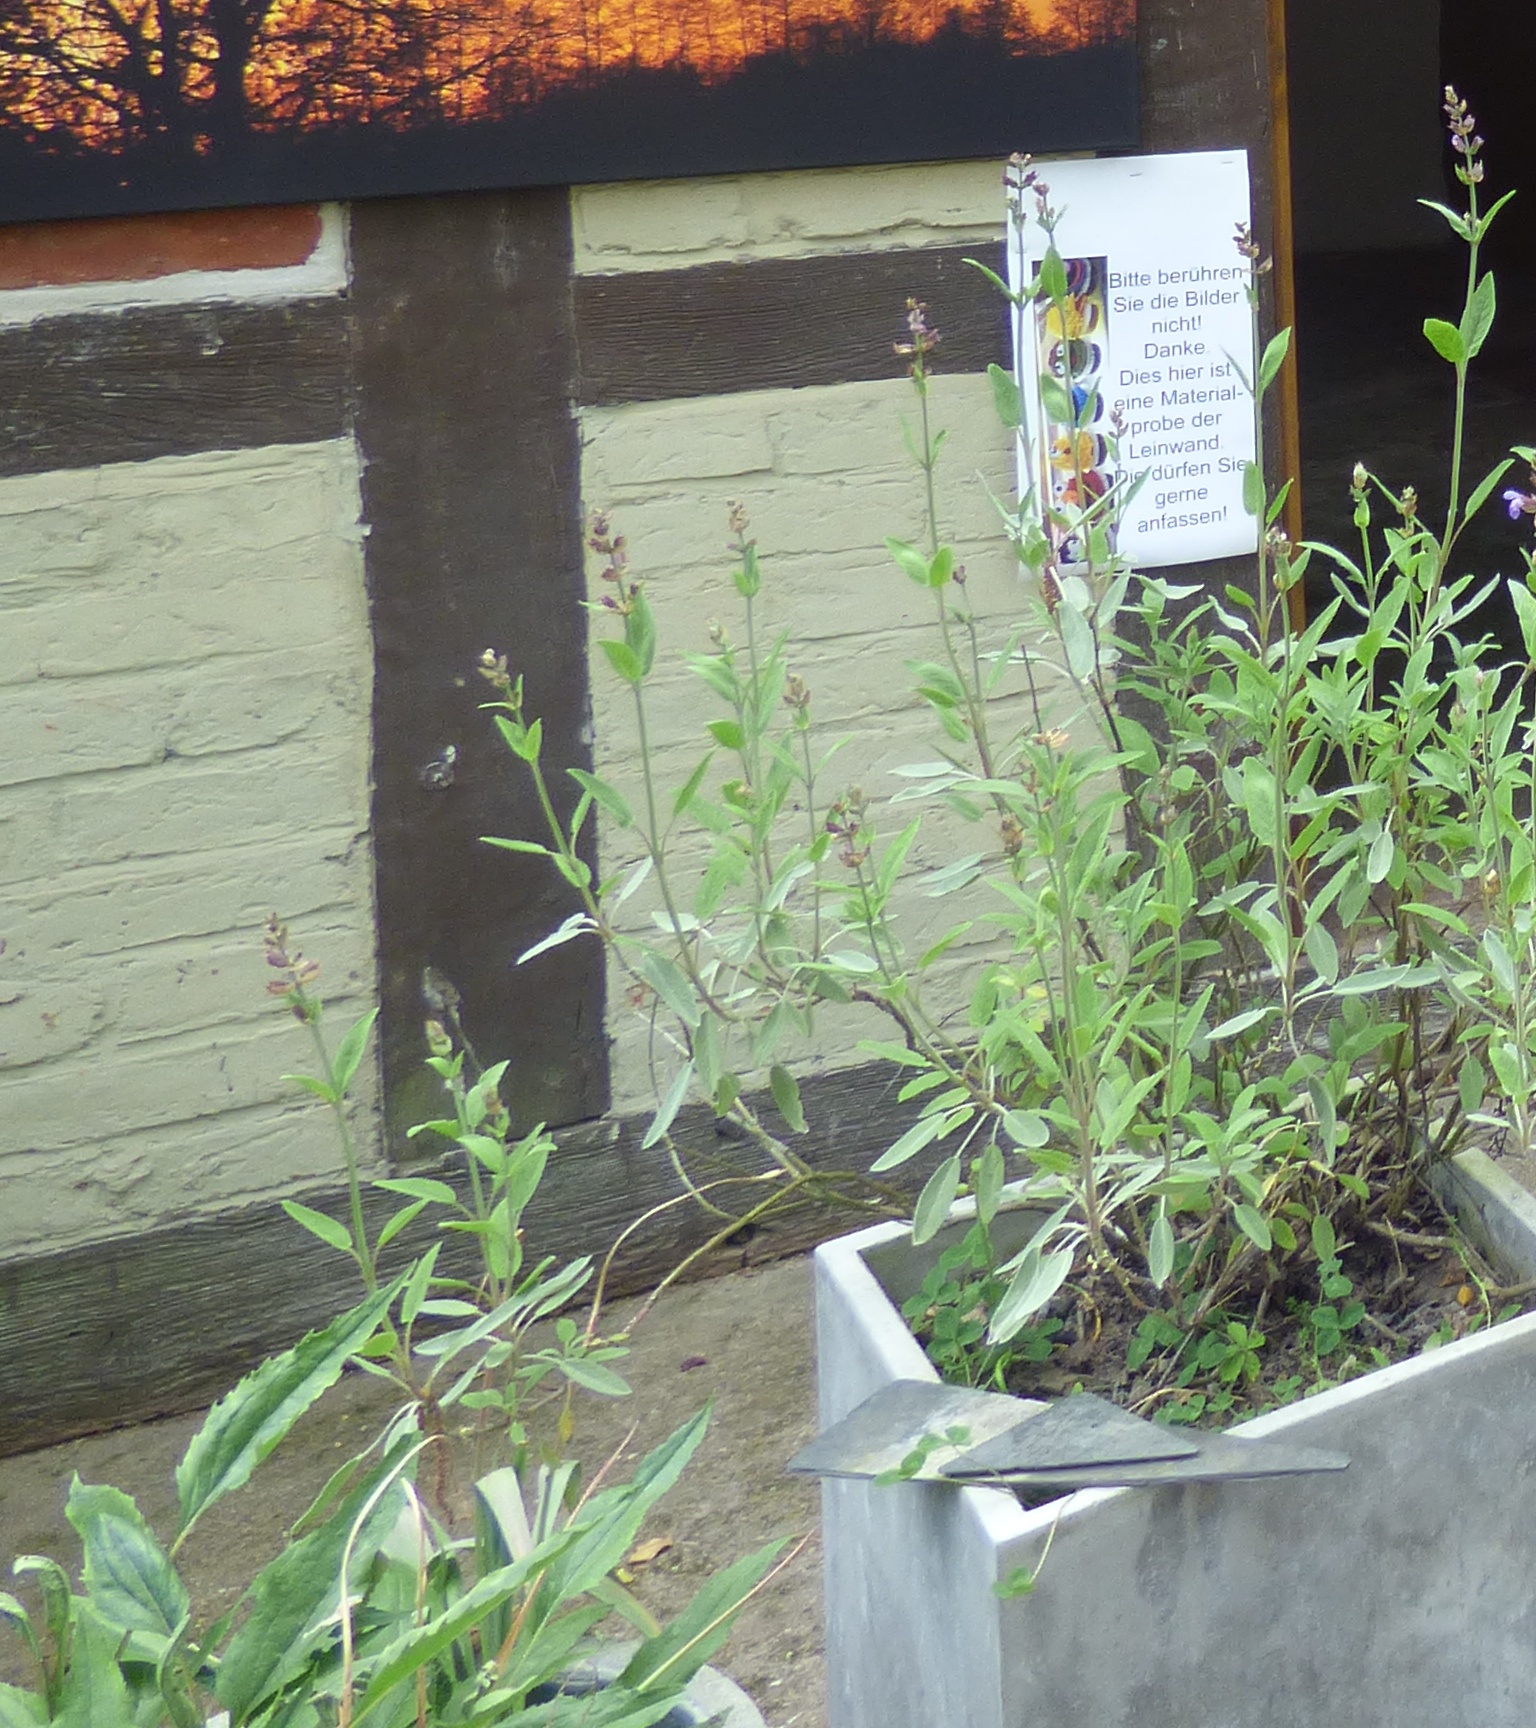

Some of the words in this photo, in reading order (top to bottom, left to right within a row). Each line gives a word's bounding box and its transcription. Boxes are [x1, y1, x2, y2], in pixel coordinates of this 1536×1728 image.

[1109, 271, 1151, 289] Bitte
[1158, 265, 1243, 285] berühren
[1113, 296, 1144, 313] Sie
[1150, 292, 1179, 310] die
[1185, 289, 1240, 307] Bilder
[1152, 315, 1202, 333] nicht!
[1120, 369, 1162, 386] Dies
[1168, 364, 1204, 382] hier
[1210, 362, 1232, 378] ist
[1114, 394, 1154, 411] eine
[1161, 385, 1244, 406] Material-
[1131, 415, 1185, 438] probe
[1191, 412, 1222, 428] der
[1151, 461, 1211, 481] dürfen
[1218, 456, 1247, 473] Sie
[1155, 486, 1208, 509] gerne
[1138, 505, 1228, 533] anfassen!
